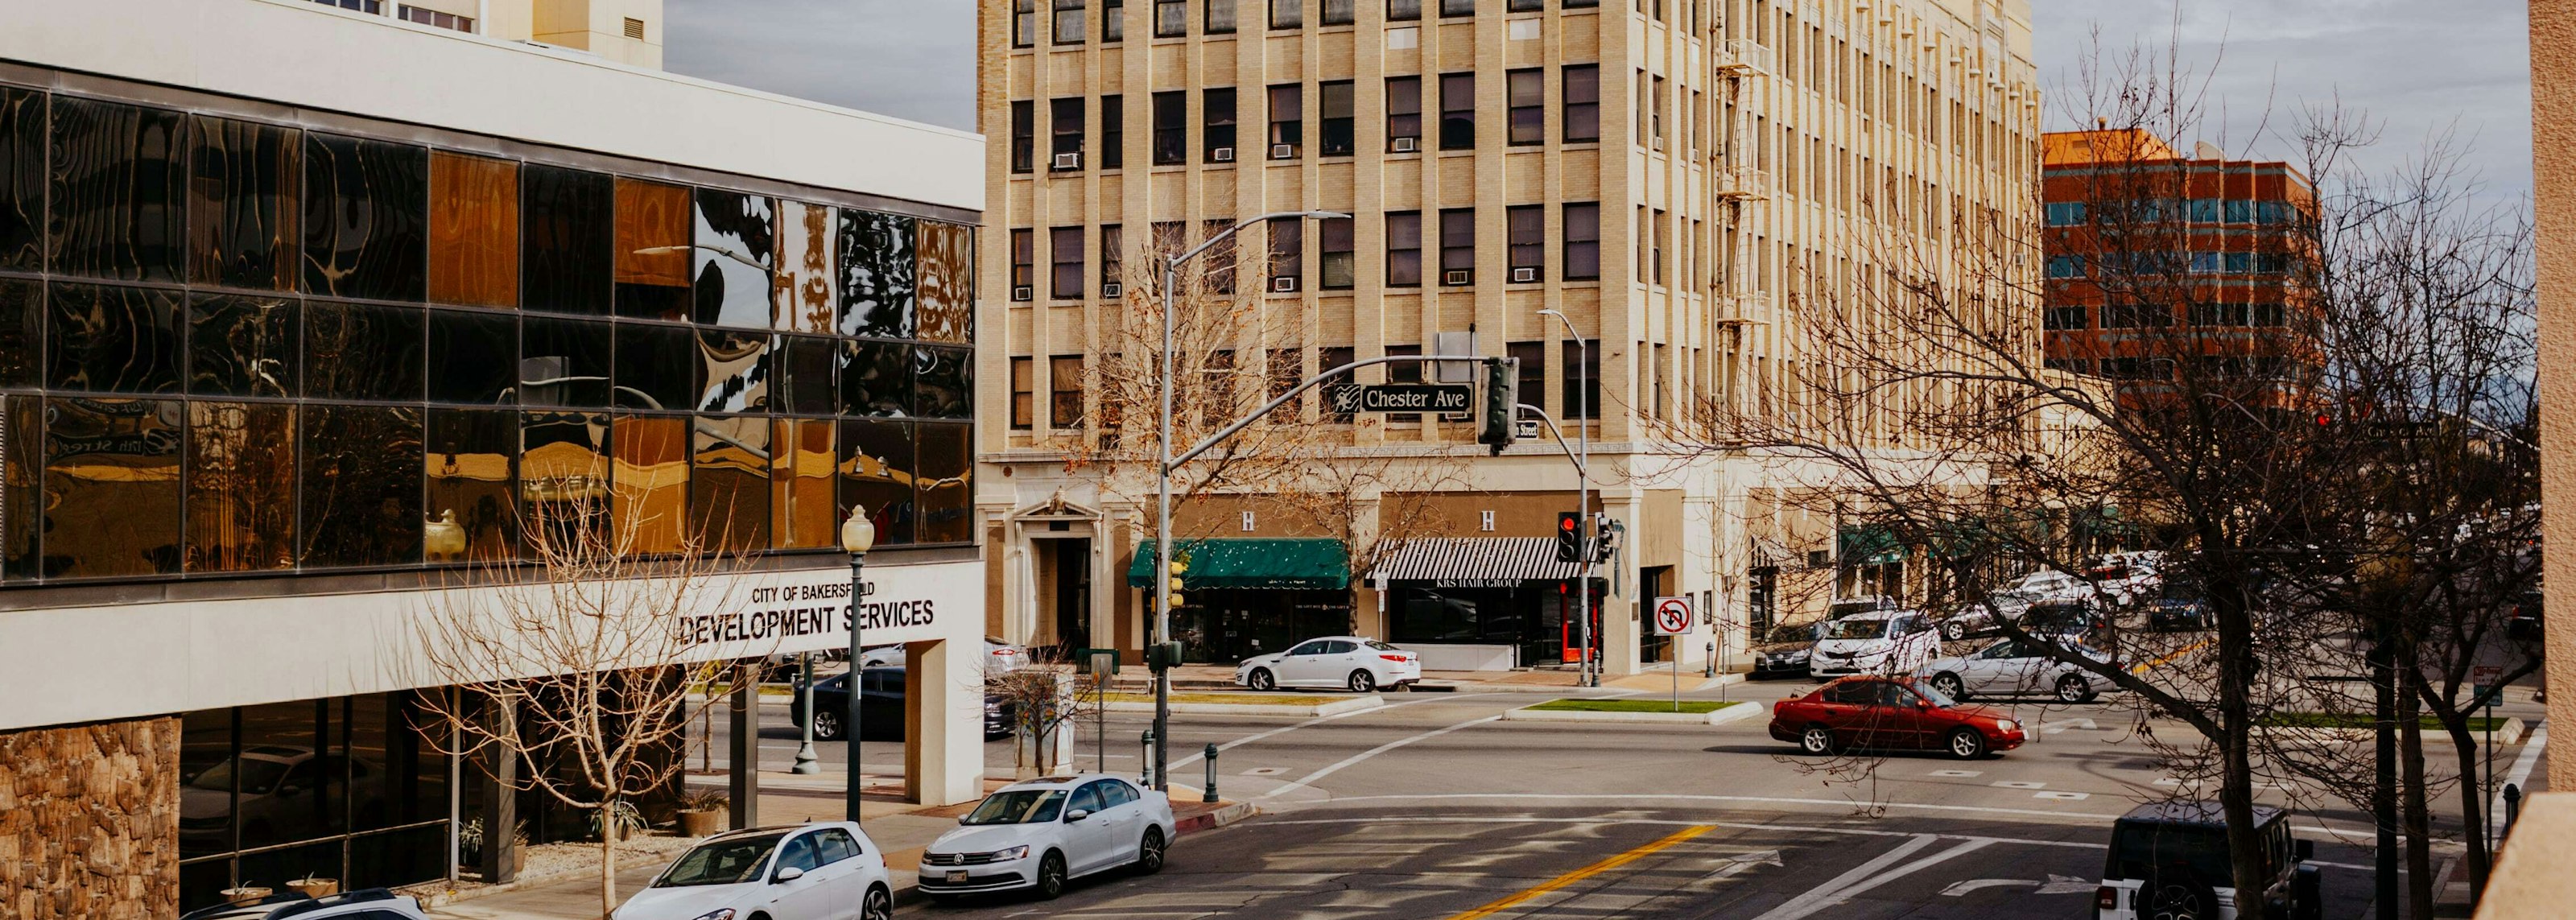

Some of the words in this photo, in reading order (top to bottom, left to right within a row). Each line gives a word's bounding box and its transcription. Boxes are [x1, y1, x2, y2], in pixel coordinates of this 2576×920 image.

[1367, 390, 1428, 408] Chester
[1435, 390, 1465, 408] Ave
[1520, 424, 1538, 436] Street
[1242, 510, 1255, 532] H
[1481, 510, 1495, 531] H
[752, 587, 778, 604] CITY
[783, 586, 798, 602] OF
[802, 582, 875, 600] BAKERSFD
[1436, 579, 1457, 588] KRS
[1459, 579, 1484, 588] HAIR
[1486, 579, 1522, 588] GROUP
[679, 606, 836, 646] DEVELOPMENT
[843, 600, 934, 631] SERVICES
